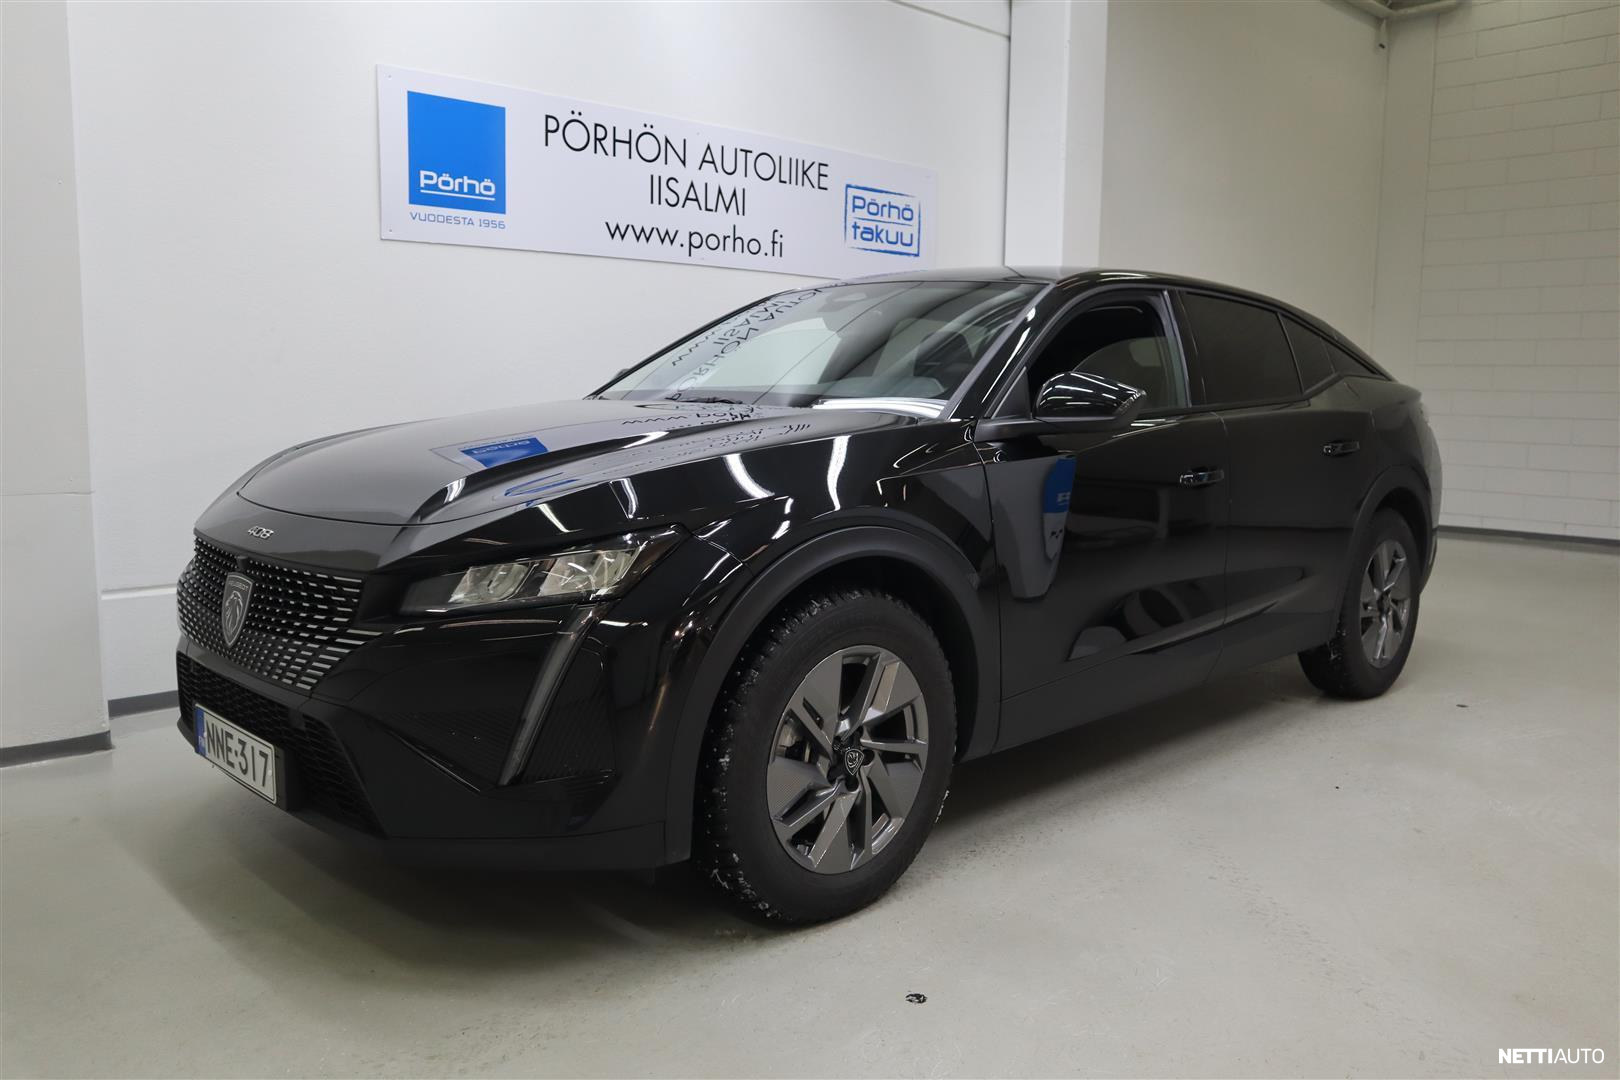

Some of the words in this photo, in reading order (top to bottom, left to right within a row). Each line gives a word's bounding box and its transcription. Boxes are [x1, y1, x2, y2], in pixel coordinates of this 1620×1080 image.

[544, 109, 687, 168] PÖRHÖN
[698, 143, 829, 191] AUTOLIIKE
[419, 169, 496, 196] Pörhö
[650, 174, 746, 217] IISALMI
[409, 211, 475, 227] VUODESTA
[479, 218, 506, 230] 1956
[851, 195, 914, 222] Pörhö
[604, 221, 784, 258] www.porho.fi
[851, 221, 914, 247] takuu
[247, 525, 274, 540] 408
[205, 719, 269, 788] NNE-317
